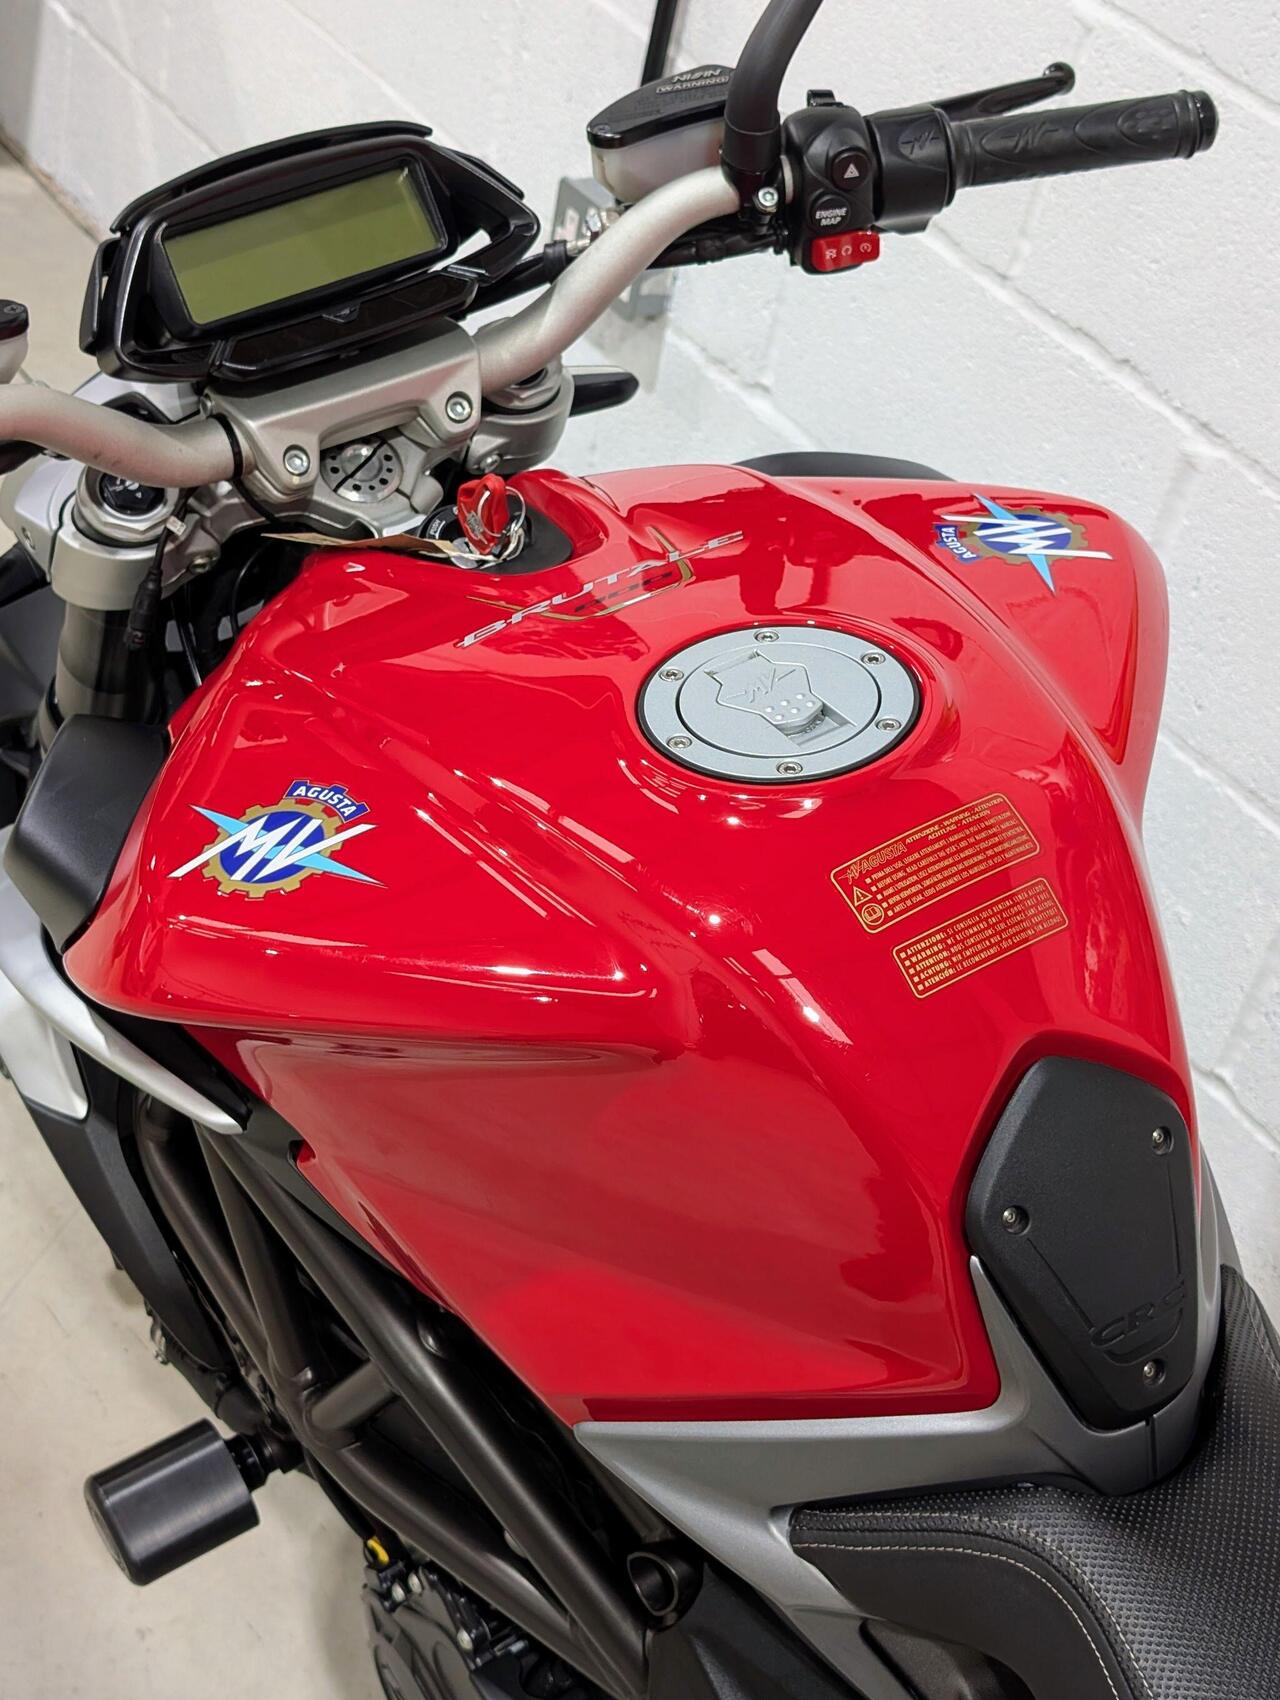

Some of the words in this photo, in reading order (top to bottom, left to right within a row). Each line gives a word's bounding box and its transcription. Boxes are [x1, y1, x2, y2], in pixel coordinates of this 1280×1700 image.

[815, 207, 848, 219] ENGINE
[820, 216, 842, 226] MAP
[941, 527, 977, 559] AGUSTA
[456, 531, 743, 648] BRUTALE
[293, 786, 357, 817] AGUSTA
[861, 842, 907, 873] AGUSTA
[907, 933, 947, 955] ATTENZIONE:
[910, 943, 945, 962] WARNING:
[946, 937, 955, 945] WE
[916, 951, 950, 971] ATTENTION:
[920, 961, 951, 979] ACHTUNG:
[924, 968, 956, 987] ATENCIÓN:
